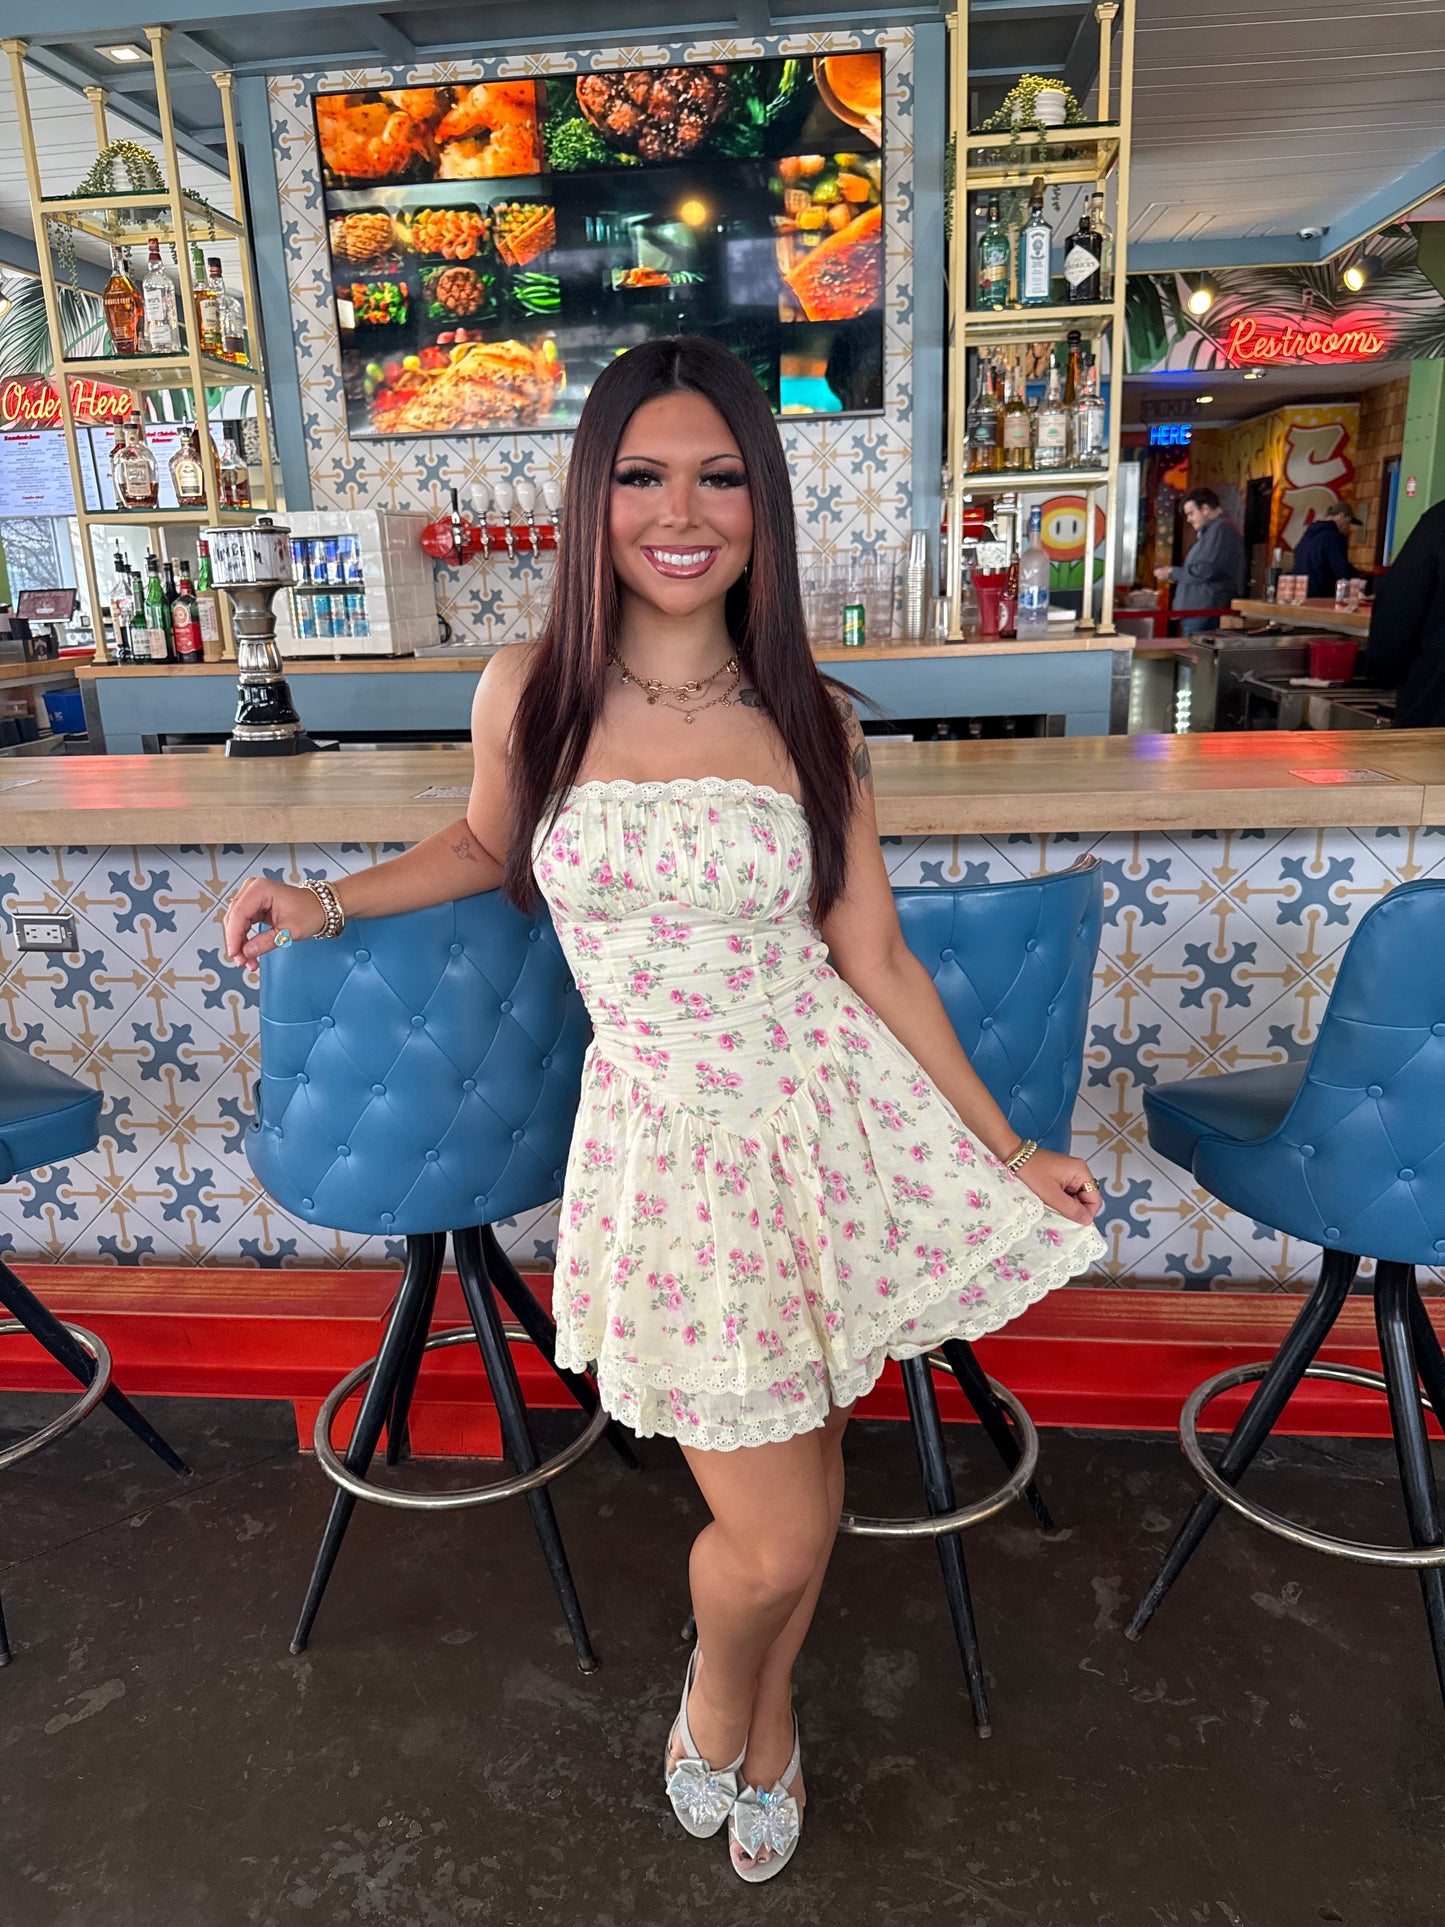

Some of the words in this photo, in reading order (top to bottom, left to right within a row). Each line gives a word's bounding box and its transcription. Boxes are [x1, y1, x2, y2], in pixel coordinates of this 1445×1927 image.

[1227, 317, 1384, 360] Restrooms
[73, 379, 132, 417] Here
[1150, 424, 1192, 446] HERE
